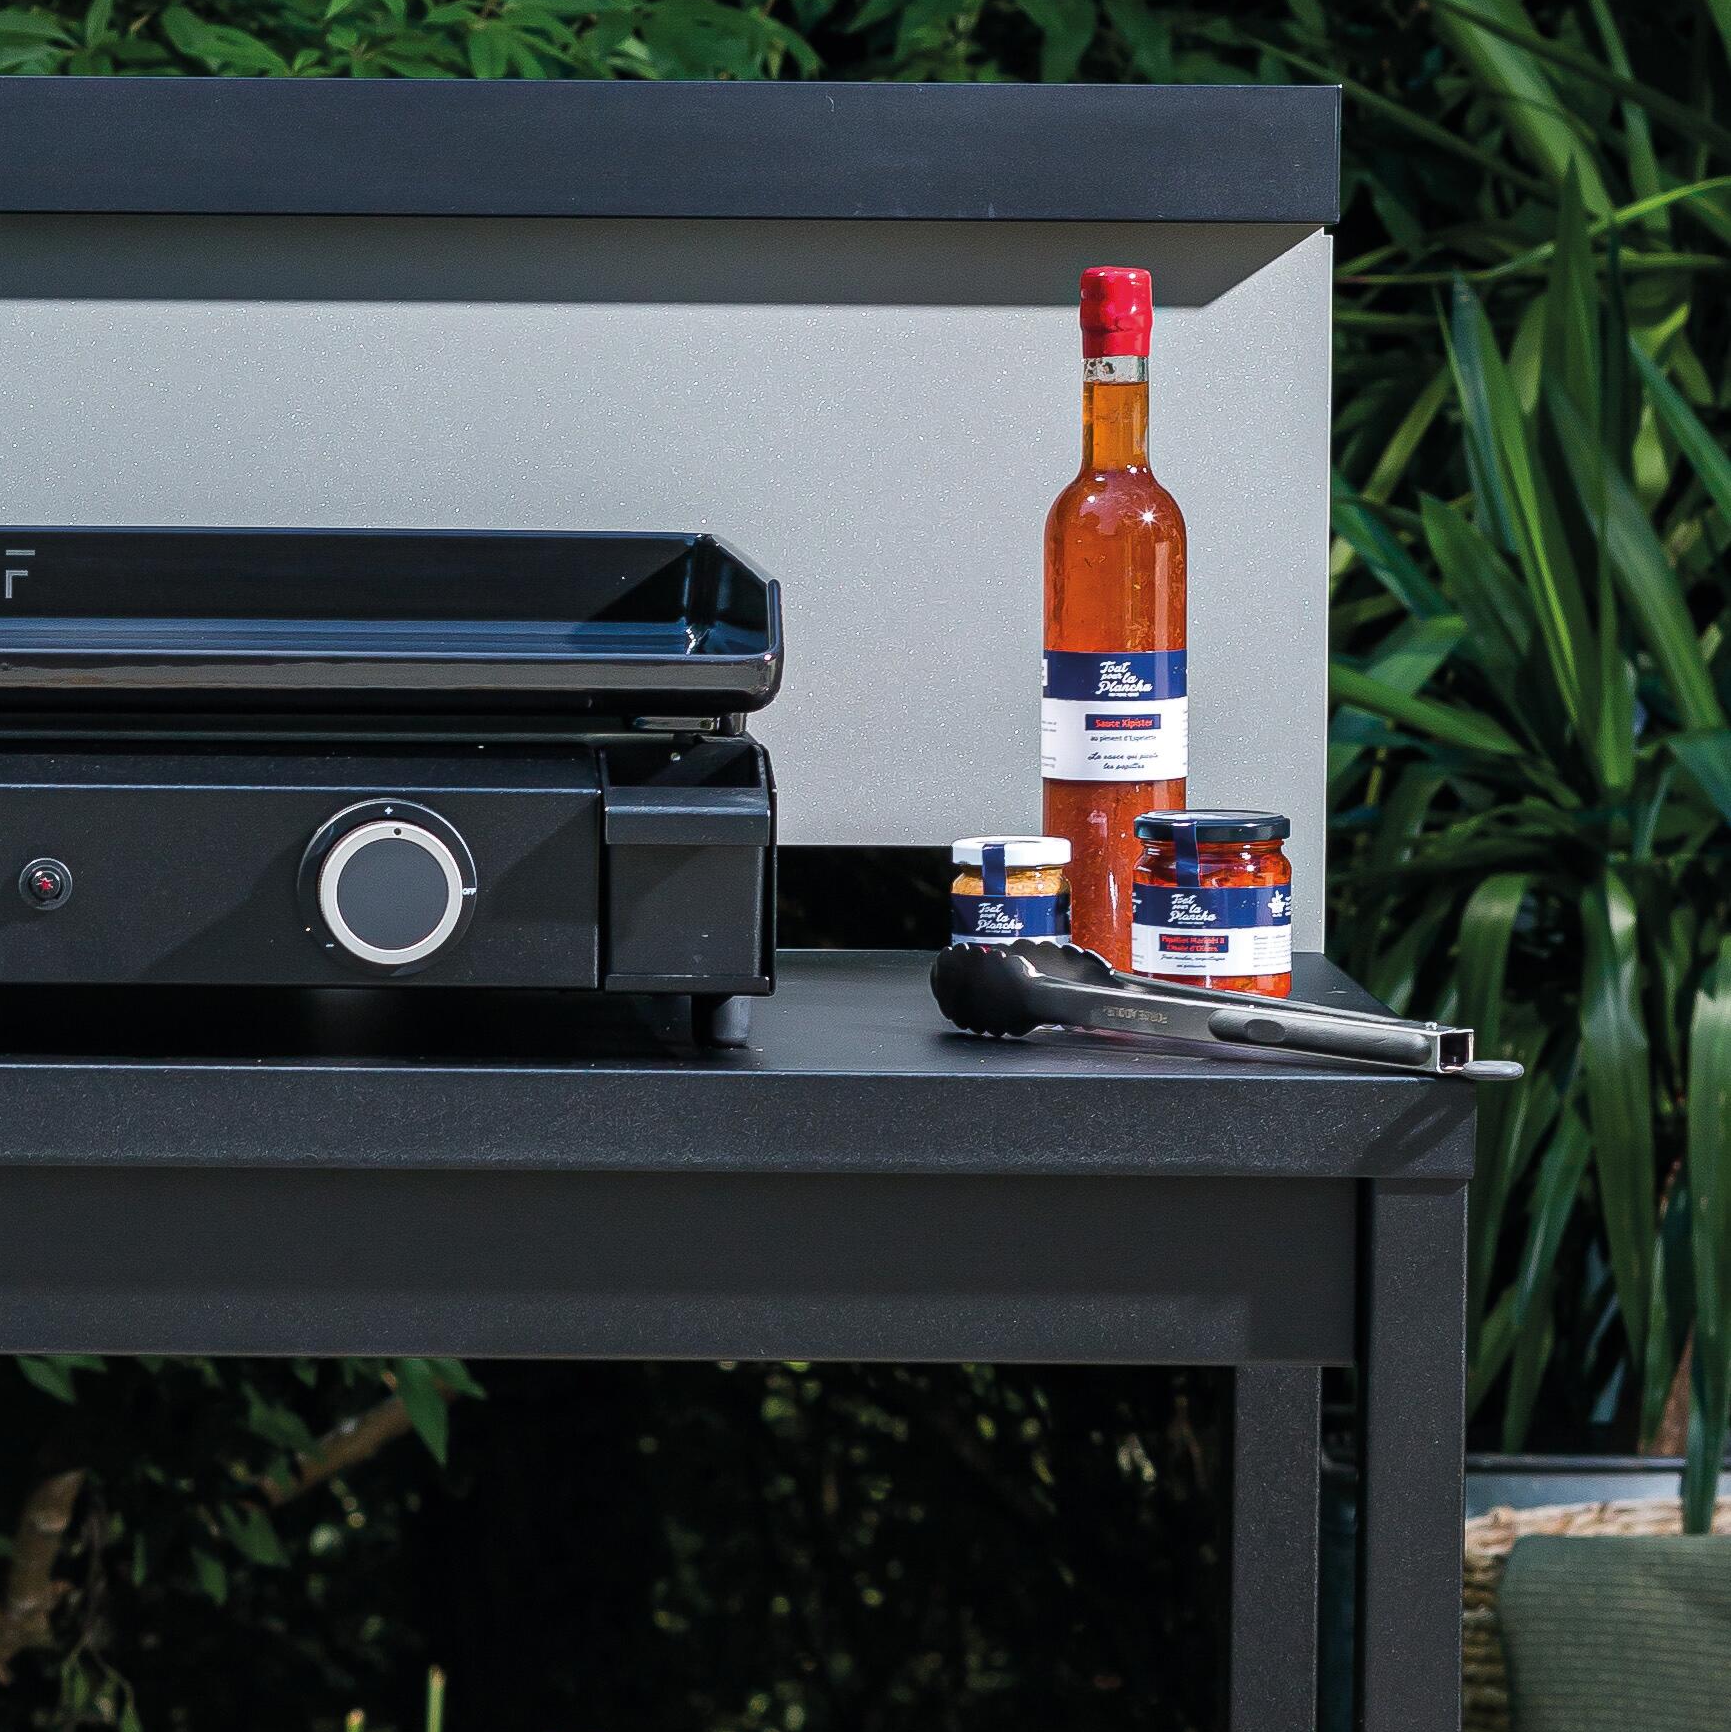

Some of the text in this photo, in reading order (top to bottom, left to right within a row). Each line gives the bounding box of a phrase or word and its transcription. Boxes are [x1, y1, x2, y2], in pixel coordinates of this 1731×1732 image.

[1099, 660, 1131, 674] Tout
[1122, 672, 1138, 684] la
[1094, 679, 1153, 695] Plancha
[1188, 903, 1202, 914] la
[996, 912, 1010, 922] la
[1168, 910, 1217, 922] Plancha
[975, 919, 1024, 931] Plancha
